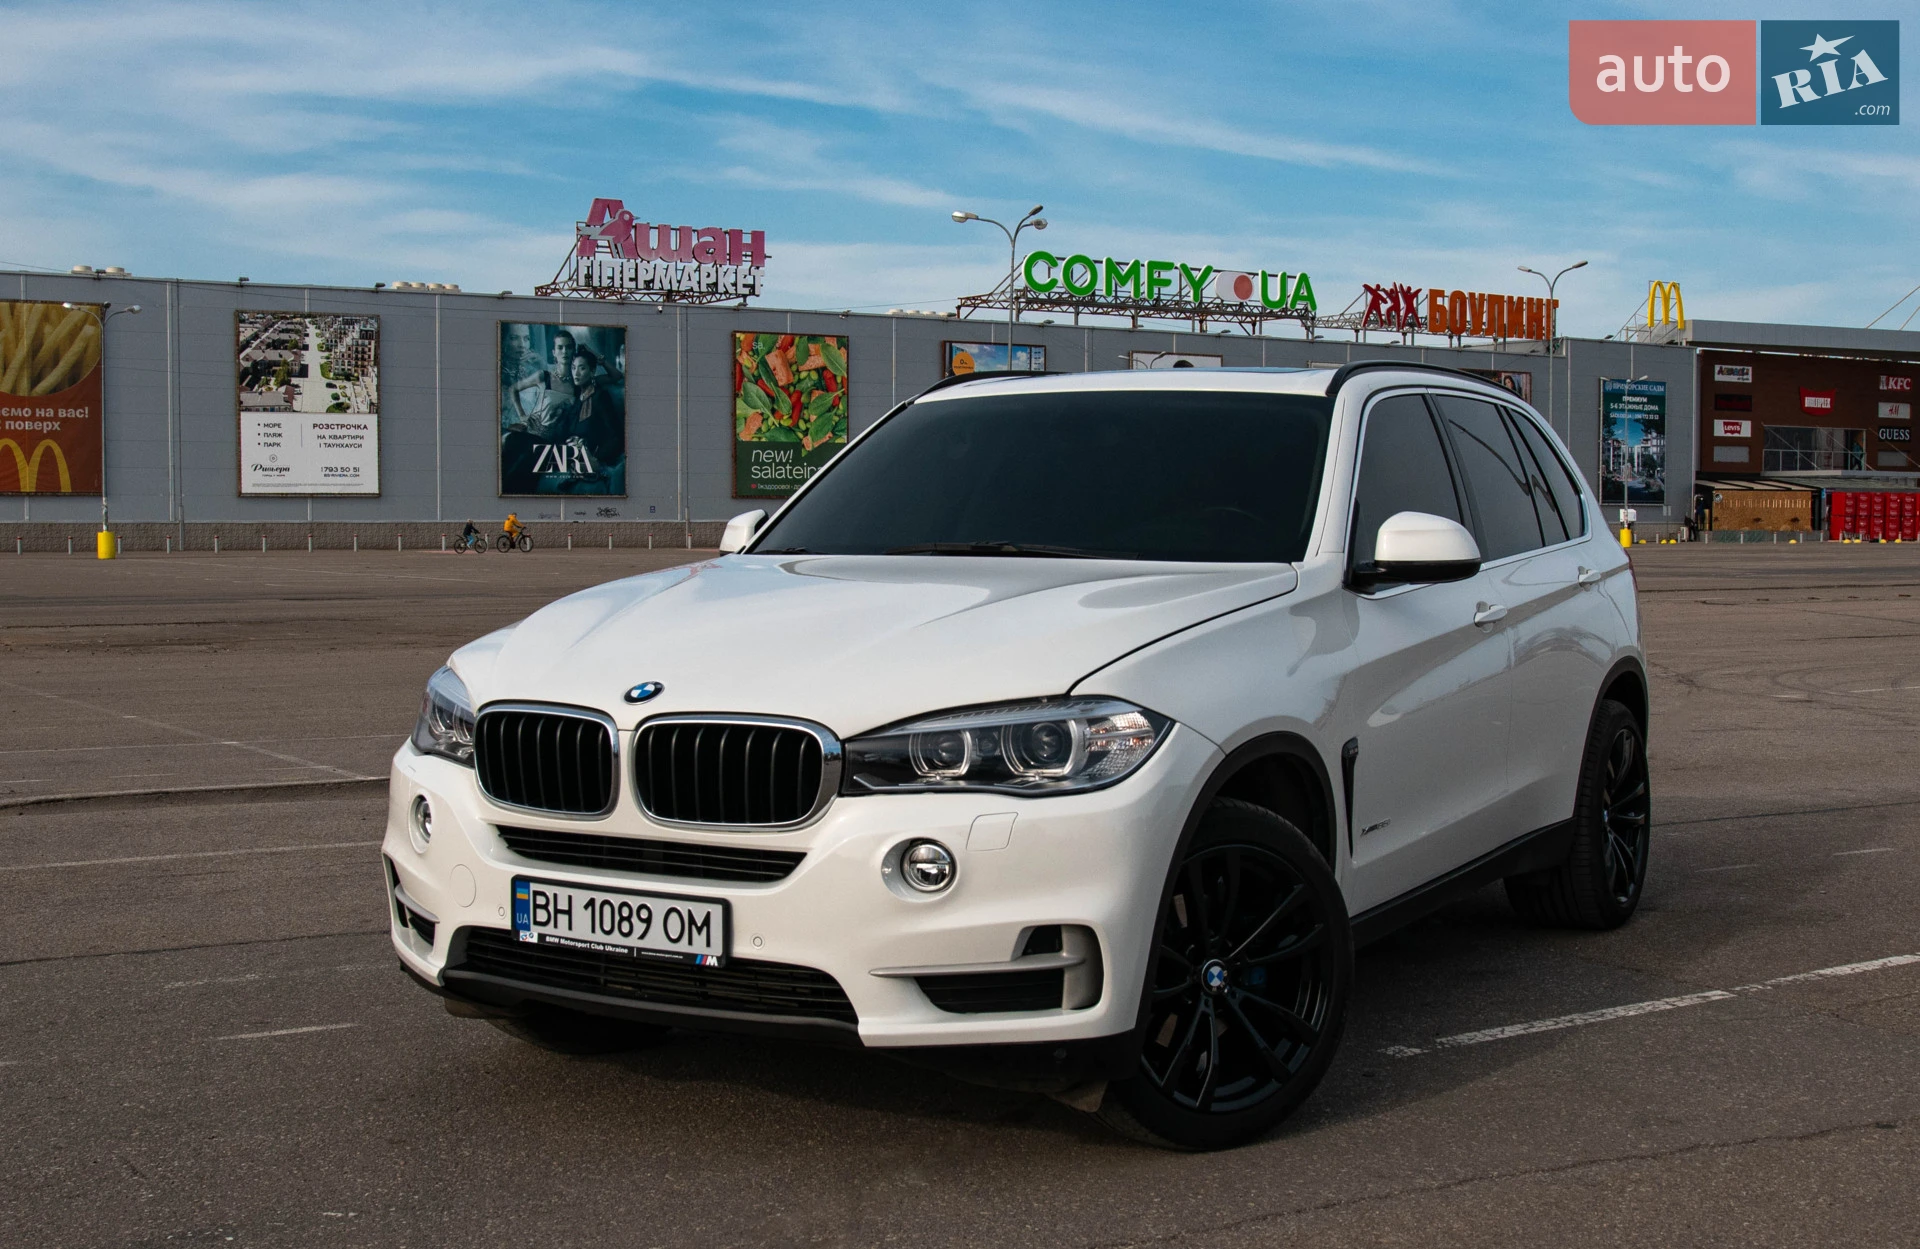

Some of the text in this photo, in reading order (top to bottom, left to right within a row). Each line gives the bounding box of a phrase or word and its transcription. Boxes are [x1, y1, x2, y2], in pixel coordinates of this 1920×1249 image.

[577, 257, 765, 297] ГІПЕРМАРКЕТ
[1021, 249, 1318, 312] COMFY UA
[1427, 288, 1559, 341] БОУЛИНГ
[1888, 376, 1911, 390] KFC
[35, 407, 54, 417] на
[58, 406, 89, 418] вас!
[5, 420, 61, 434] поверх
[1878, 428, 1910, 441] GUESS
[532, 443, 595, 474] ZARA
[751, 449, 794, 463] new!
[516, 912, 529, 926] UA
[532, 889, 711, 948] BH 1089 OM
[545, 935, 559, 944] BMW
[560, 938, 590, 949] Motorsport
[605, 945, 628, 954] Ukraine
